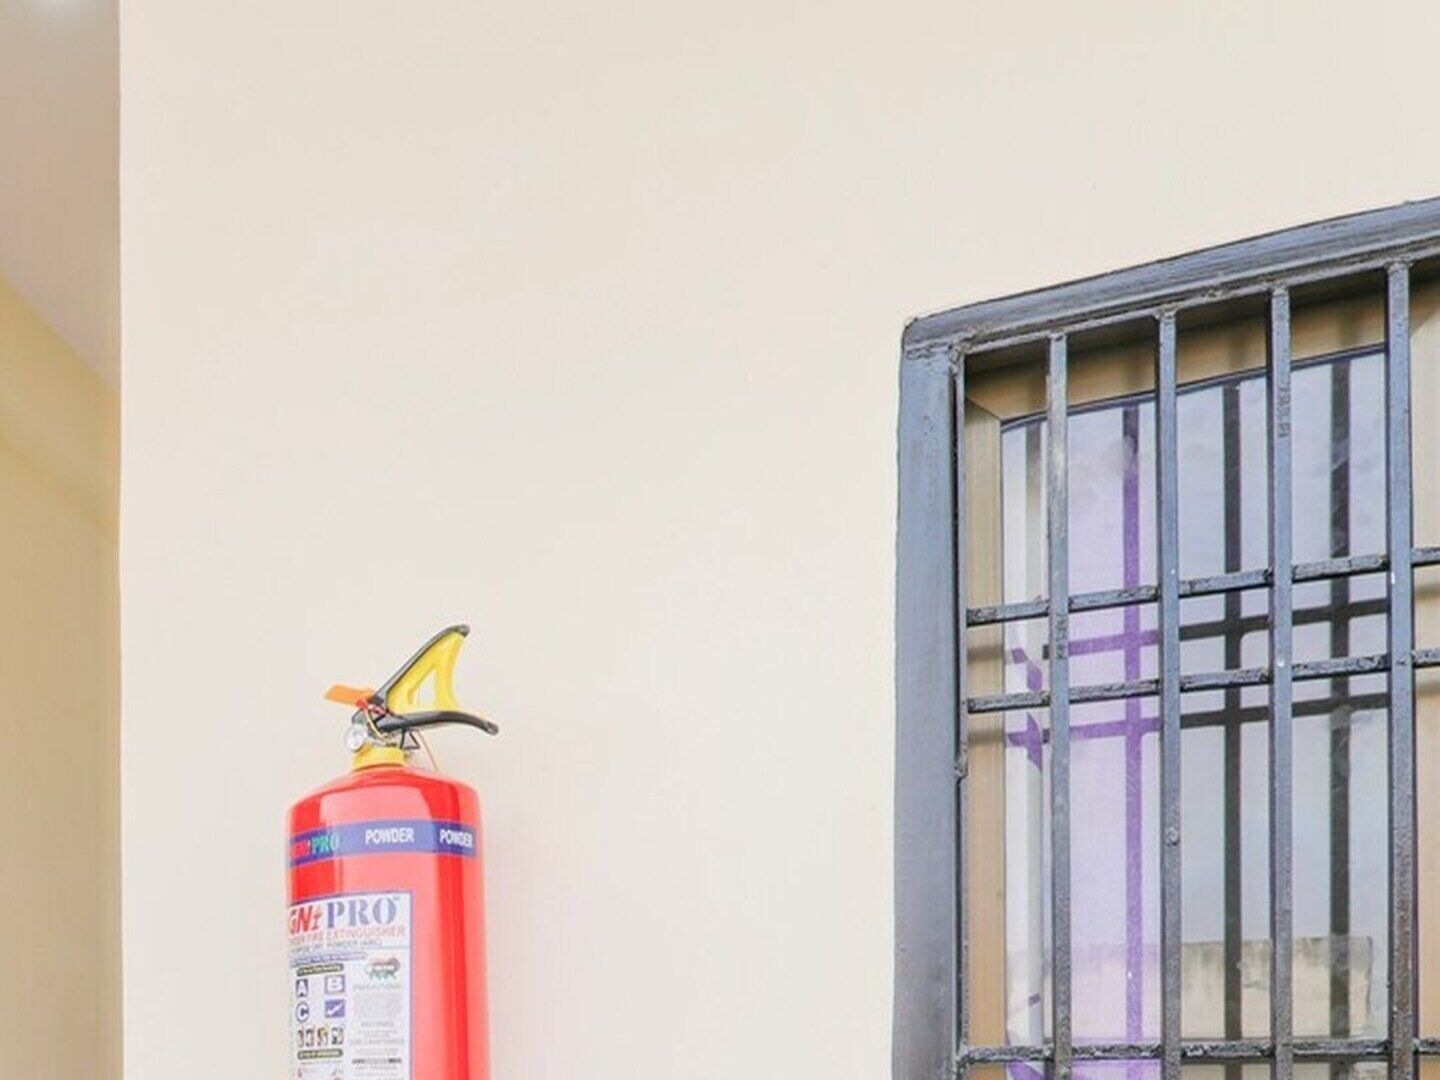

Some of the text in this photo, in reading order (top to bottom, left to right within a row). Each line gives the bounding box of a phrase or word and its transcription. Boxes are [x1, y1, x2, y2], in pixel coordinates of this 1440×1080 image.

[365, 827, 415, 844] POWDER
[439, 829, 473, 848] POWDER
[327, 897, 397, 928] PRO
[297, 976, 343, 996] A B
[297, 1004, 308, 1021] C
